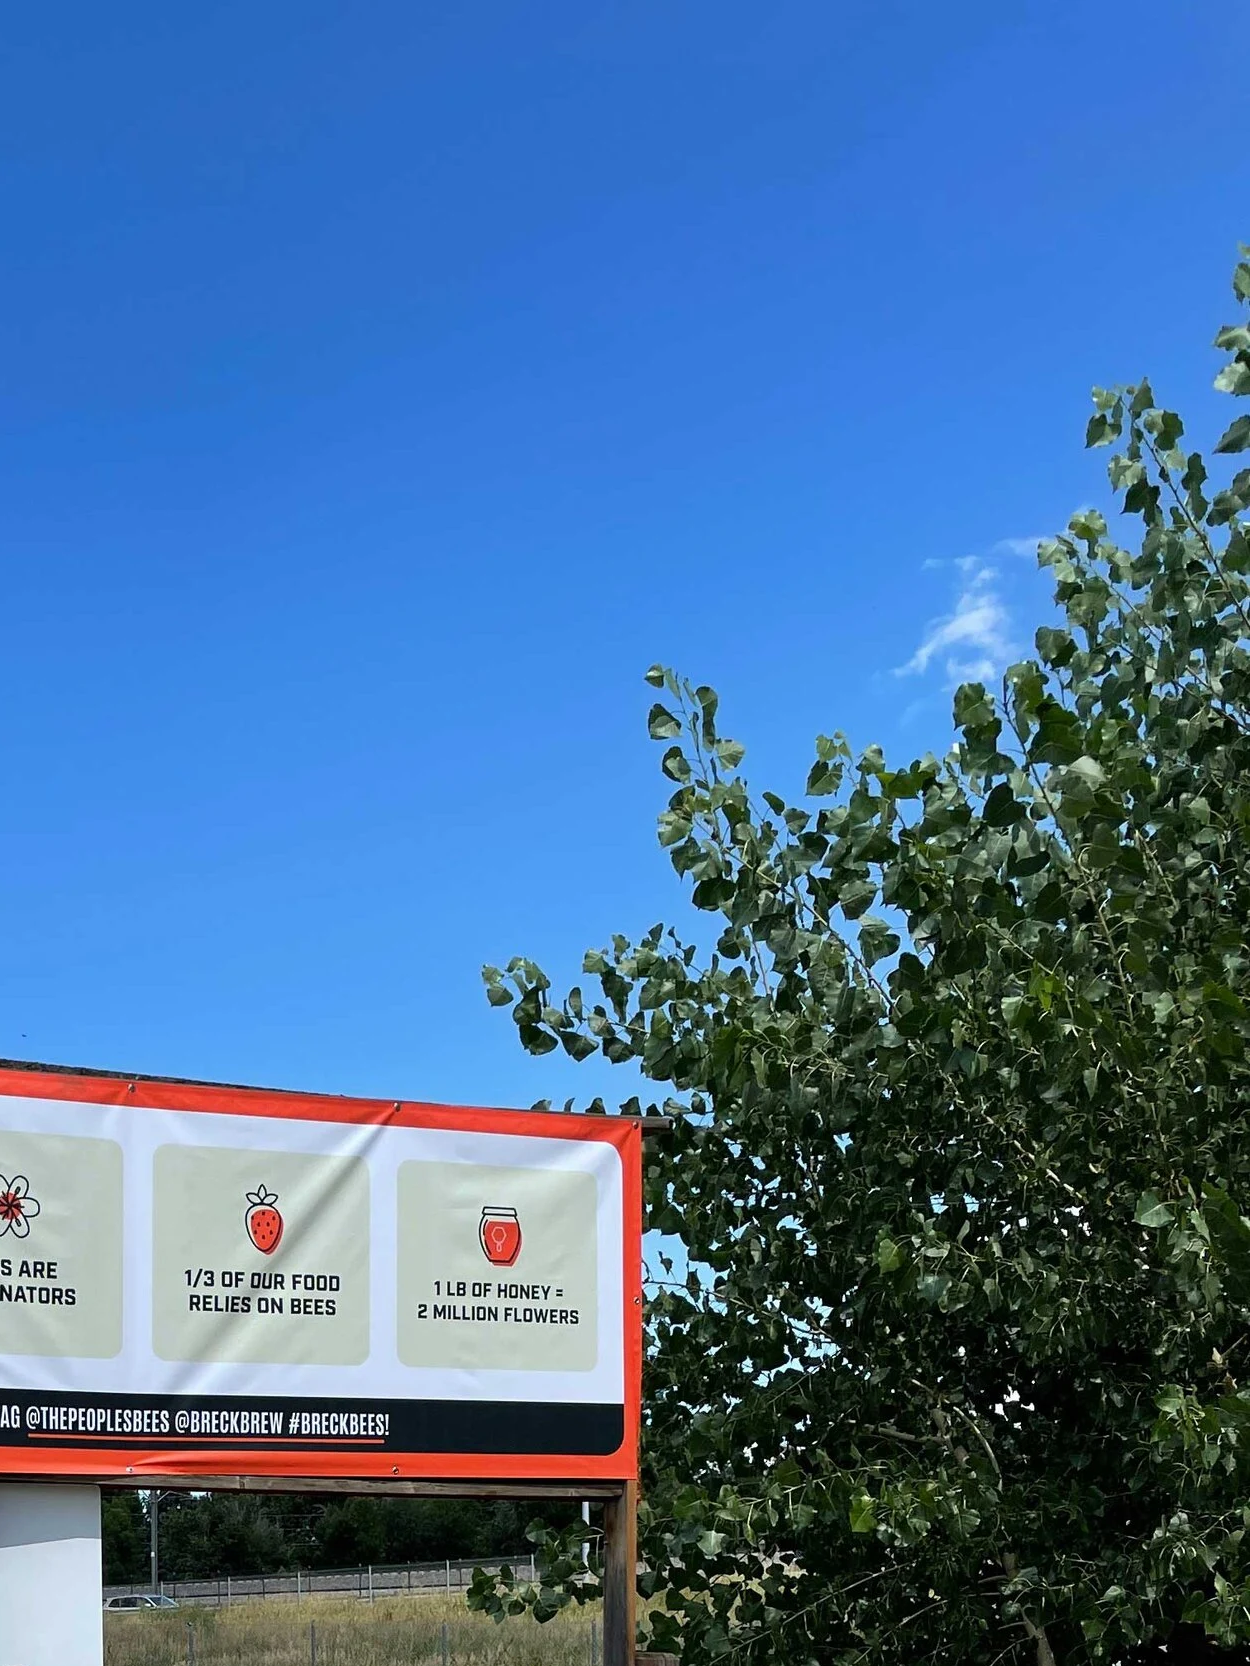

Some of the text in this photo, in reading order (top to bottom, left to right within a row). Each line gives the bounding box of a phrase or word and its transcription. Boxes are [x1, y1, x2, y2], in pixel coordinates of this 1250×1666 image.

[19, 1260, 57, 1279] ARE
[185, 1268, 340, 1292] 1/3 OF OUR FOOD
[434, 1281, 440, 1296] 1
[447, 1281, 466, 1296] LB
[472, 1282, 492, 1298] OF
[497, 1283, 551, 1300] HONEY
[189, 1294, 336, 1316] RELIES ON BEES
[418, 1304, 579, 1324] 2 MILLION FLOWERS
[26, 1406, 170, 1433] @THEPEOPLESBEES
[175, 1410, 283, 1434] @BRECKBREW
[289, 1412, 389, 1436] #BRECKBEES!
